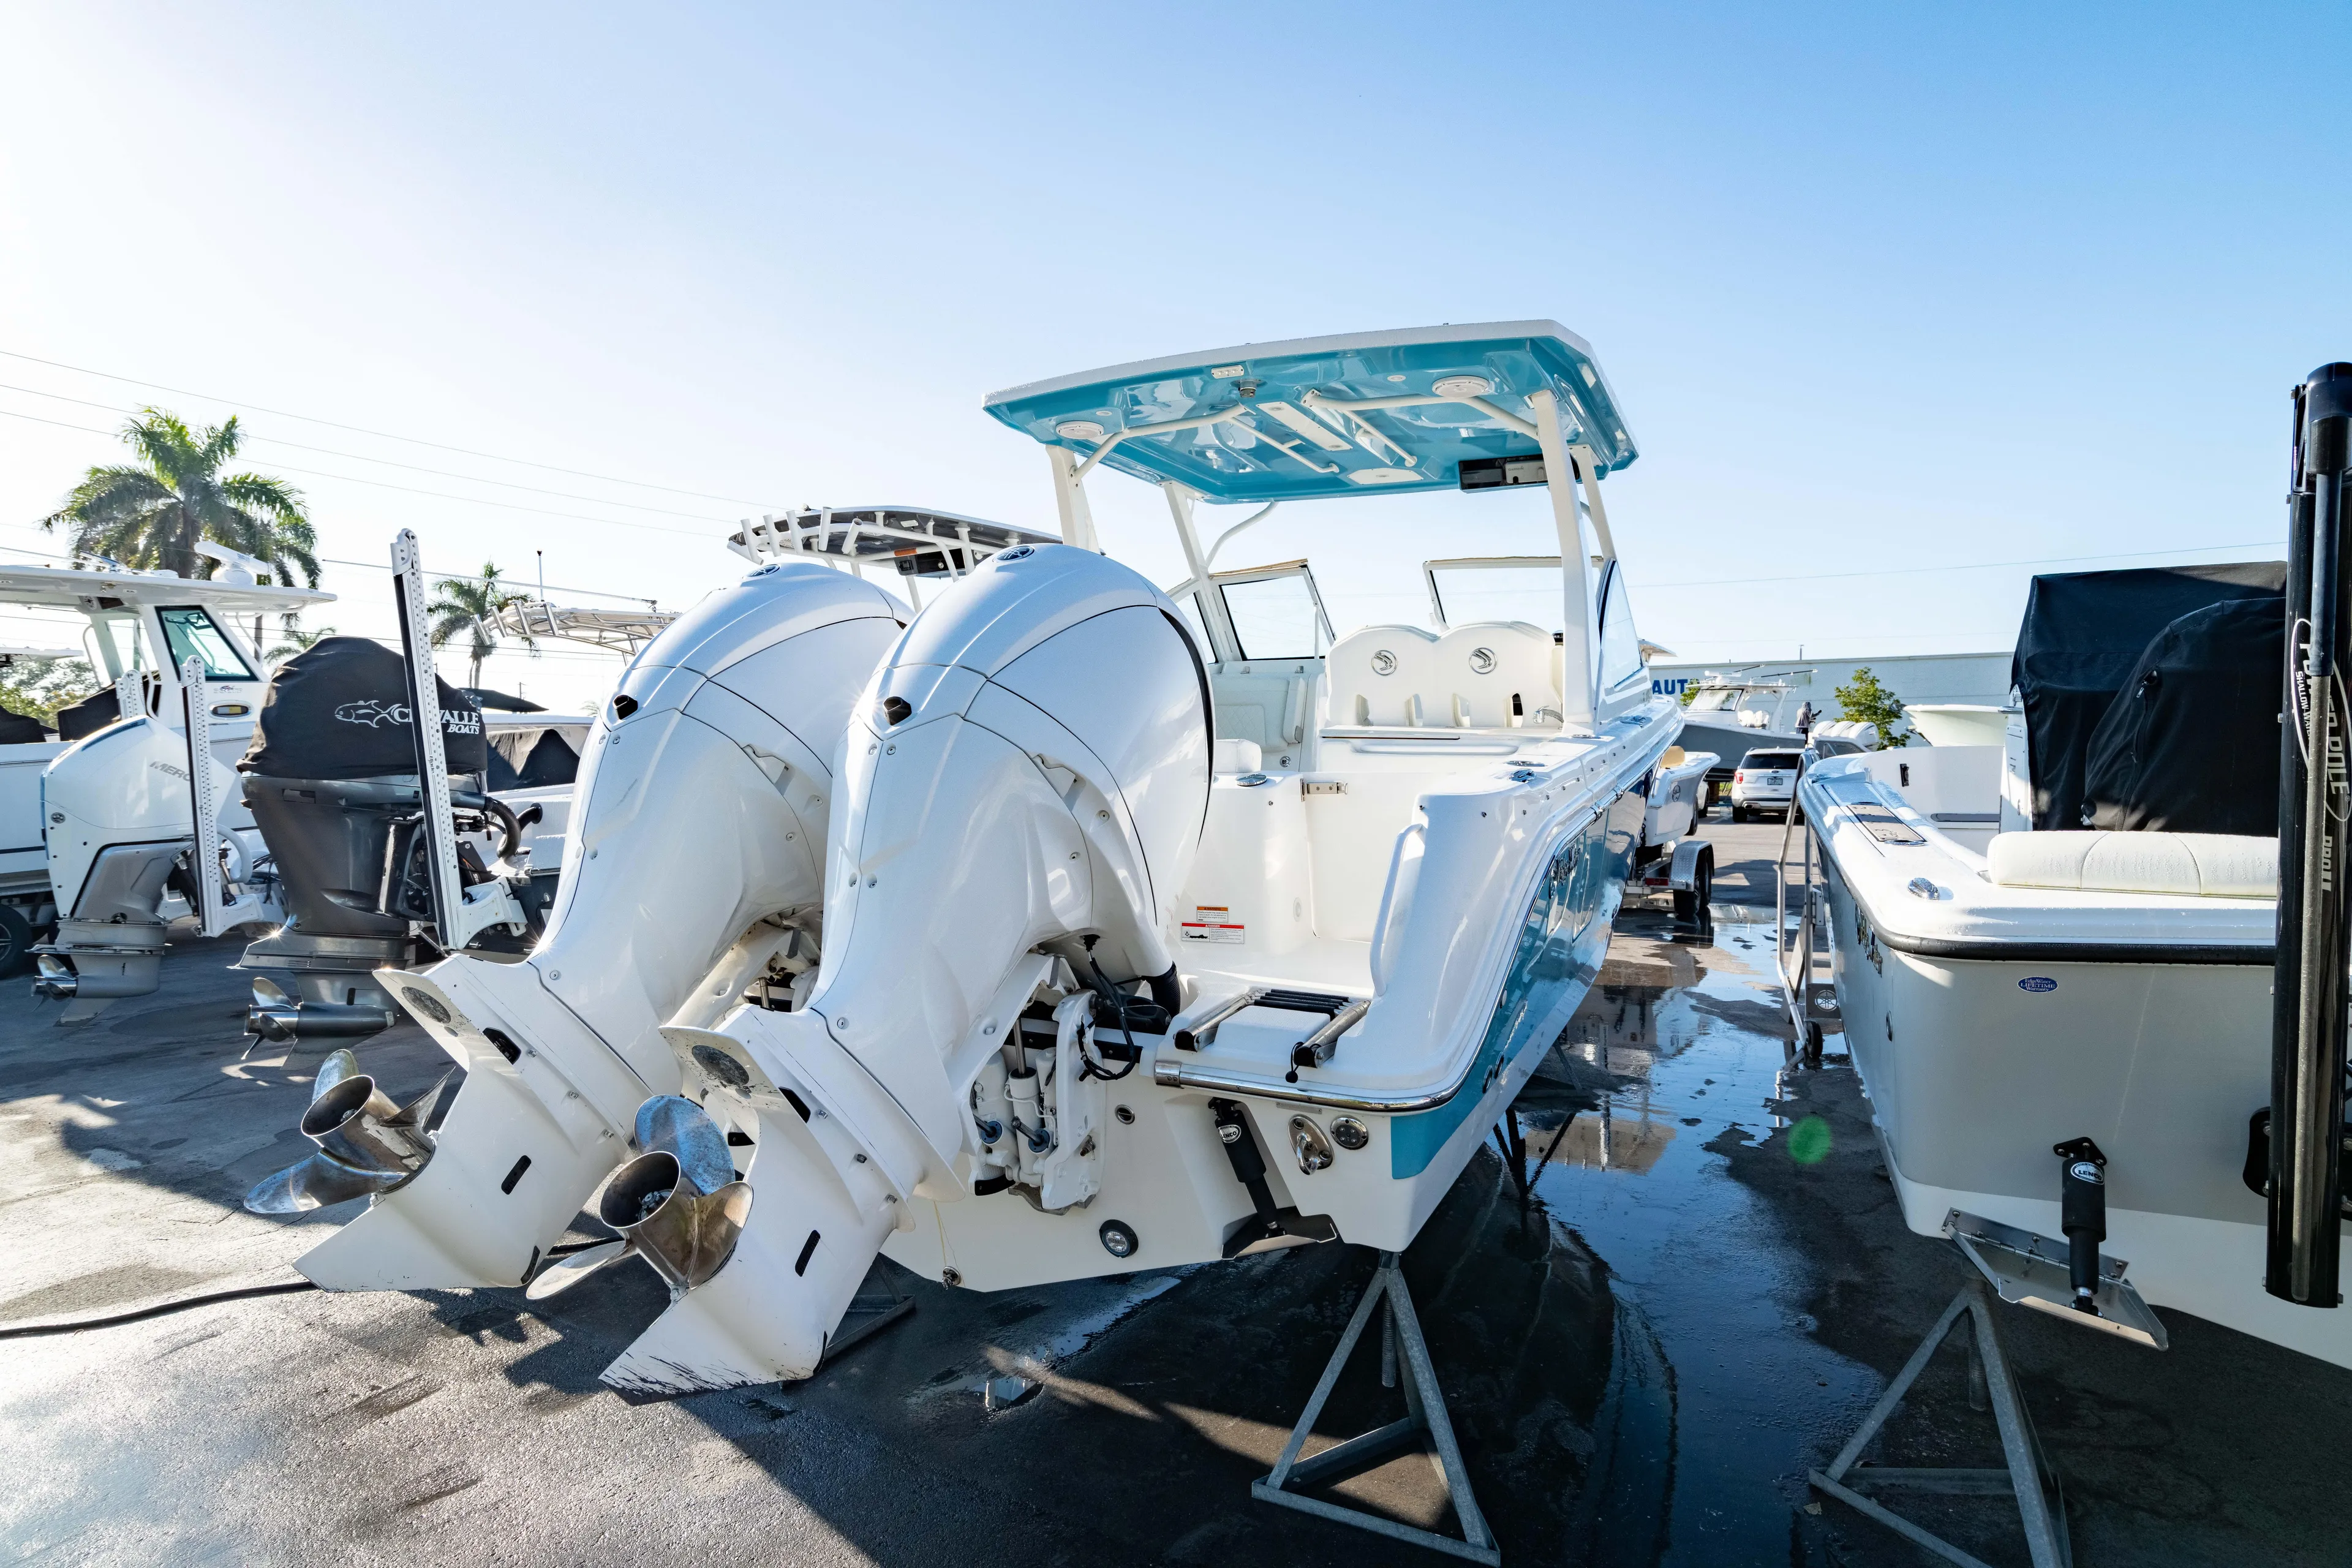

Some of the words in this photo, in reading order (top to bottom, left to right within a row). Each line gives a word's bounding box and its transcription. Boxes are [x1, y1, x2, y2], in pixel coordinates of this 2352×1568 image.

[1653, 679, 1699, 695] AUT
[2296, 671, 2309, 709] SHALLOW
[447, 723, 480, 734] BOATS
[2078, 1170, 2102, 1180] LENCO
